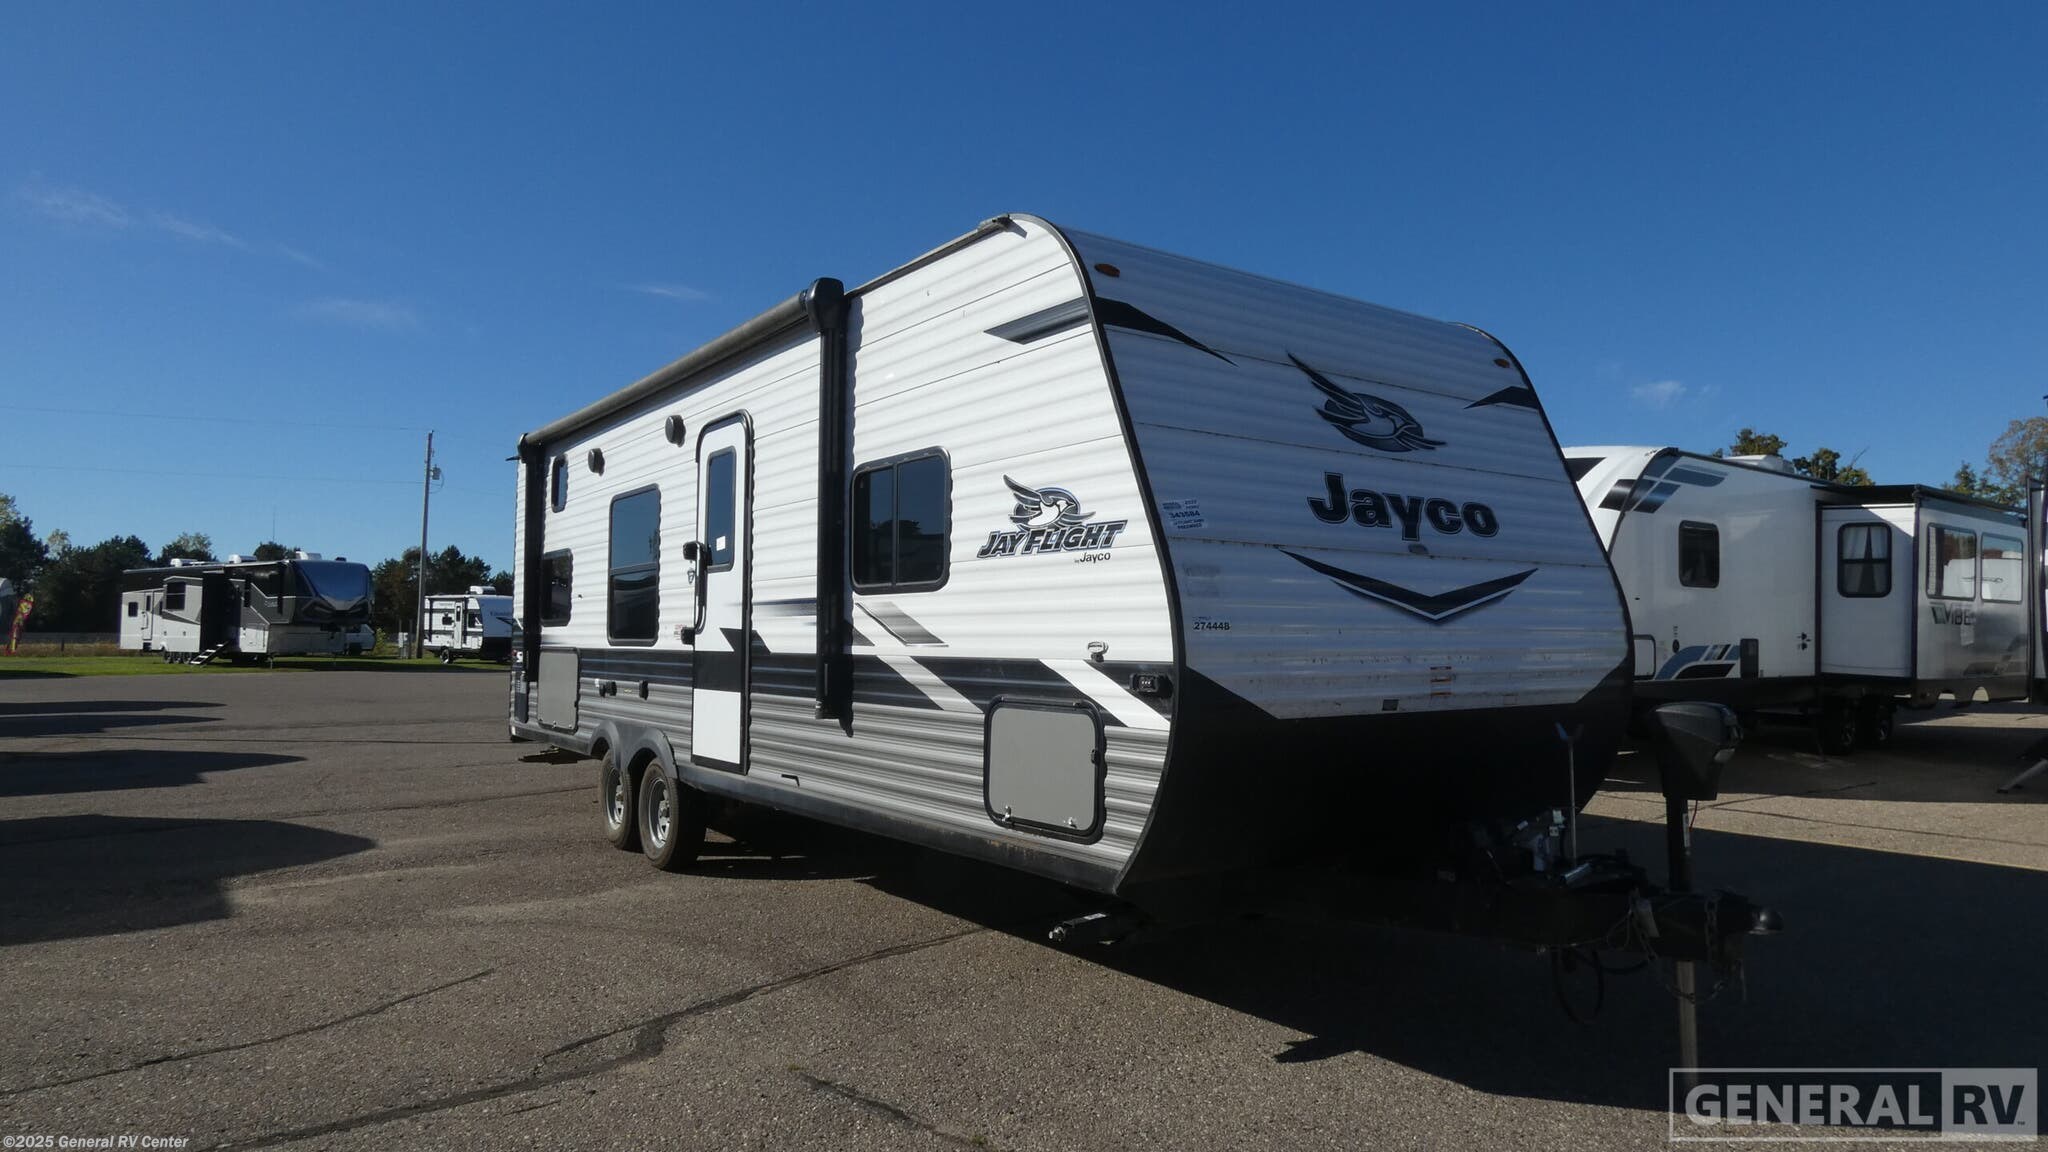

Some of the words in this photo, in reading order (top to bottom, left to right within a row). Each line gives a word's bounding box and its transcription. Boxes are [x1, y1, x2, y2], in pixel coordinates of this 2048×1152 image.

[1307, 472, 1500, 541] Jayco
[977, 531, 1027, 558] JAY
[1022, 519, 1128, 554] FLIGHT
[1080, 552, 1111, 563] Jayco
